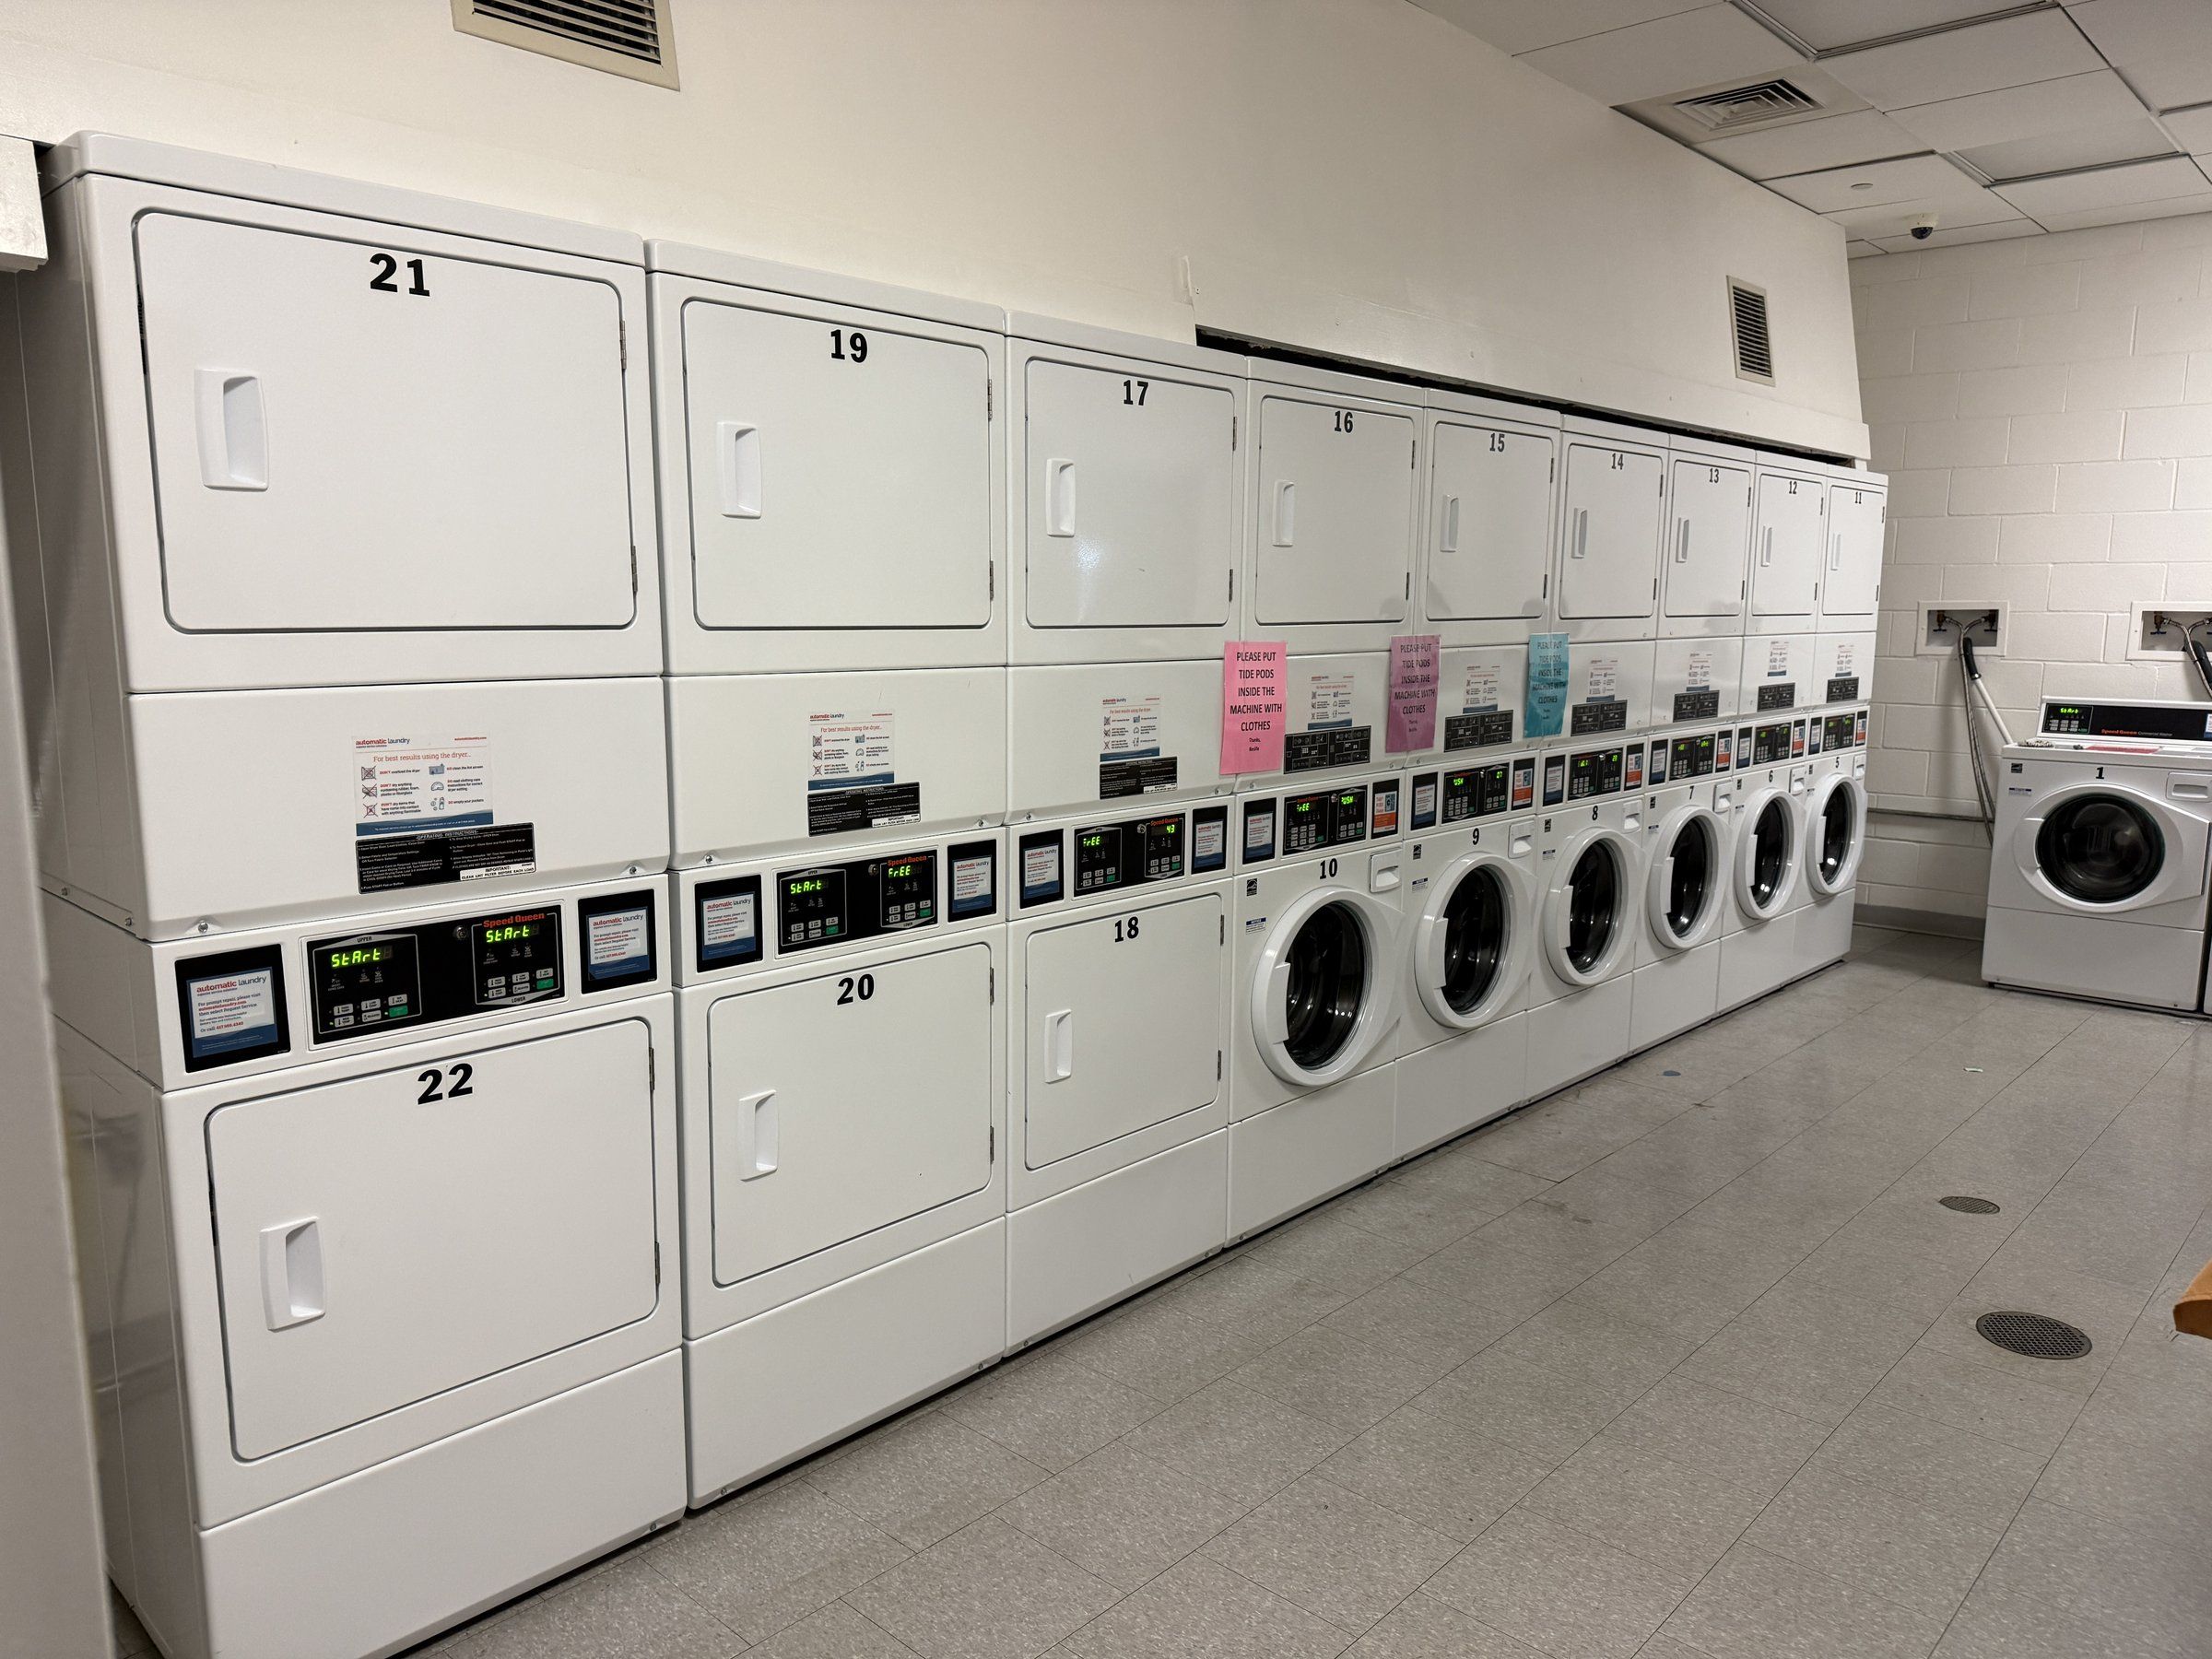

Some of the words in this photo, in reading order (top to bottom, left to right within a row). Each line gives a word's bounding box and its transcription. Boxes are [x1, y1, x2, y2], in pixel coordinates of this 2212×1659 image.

[370, 253, 431, 297] 21
[830, 329, 868, 363] 19
[1123, 380, 1149, 406] 17
[1334, 410, 1354, 434] 16
[1489, 433, 1505, 453] 15
[1611, 453, 1624, 470] 14
[1709, 467, 1720, 484] 13
[1789, 480, 1797, 495] 12
[1854, 491, 1862, 505] 11
[1401, 644, 1419, 653] PLEASE
[1420, 643, 1431, 652] PUT
[1237, 652, 1261, 661] PLEASE
[1263, 652, 1277, 661] PUT
[1403, 660, 1414, 668] TIDE
[1416, 659, 1430, 668] PODS
[1239, 669, 1254, 679] TIDE
[1256, 669, 1274, 678] PODS
[1401, 676, 1419, 684] INSIDE
[1420, 675, 1430, 683] THE
[1238, 687, 1261, 697] INSIDE
[1262, 687, 1275, 696] THE
[1394, 690, 1420, 700] MACHINE
[1421, 689, 1435, 698] WITH
[1230, 704, 1263, 714] MACHINE
[1265, 703, 1282, 712] WITH
[1403, 704, 1426, 714] CLOTHES
[1241, 721, 1270, 731] CLOTHES
[1835, 756, 1840, 769] 5
[1768, 771, 1773, 783] 6
[2095, 766, 2105, 780] 1
[1688, 785, 1695, 800] 7
[1592, 805, 1599, 821] 8
[1166, 824, 1175, 833] 43
[1472, 828, 1480, 846] 9
[887, 857, 907, 866] Speed
[907, 855, 927, 864] Queen
[888, 865, 911, 877] FrEE
[1319, 857, 1338, 880] 10
[733, 898, 751, 906] laundry
[483, 916, 513, 928] Speed
[515, 912, 545, 924] Queen
[593, 917, 622, 926] automatic
[1114, 915, 1140, 943] 18
[196, 982, 237, 993] automatic
[238, 976, 266, 986] laundry
[837, 972, 875, 1006] 20
[417, 1063, 474, 1105] 22
